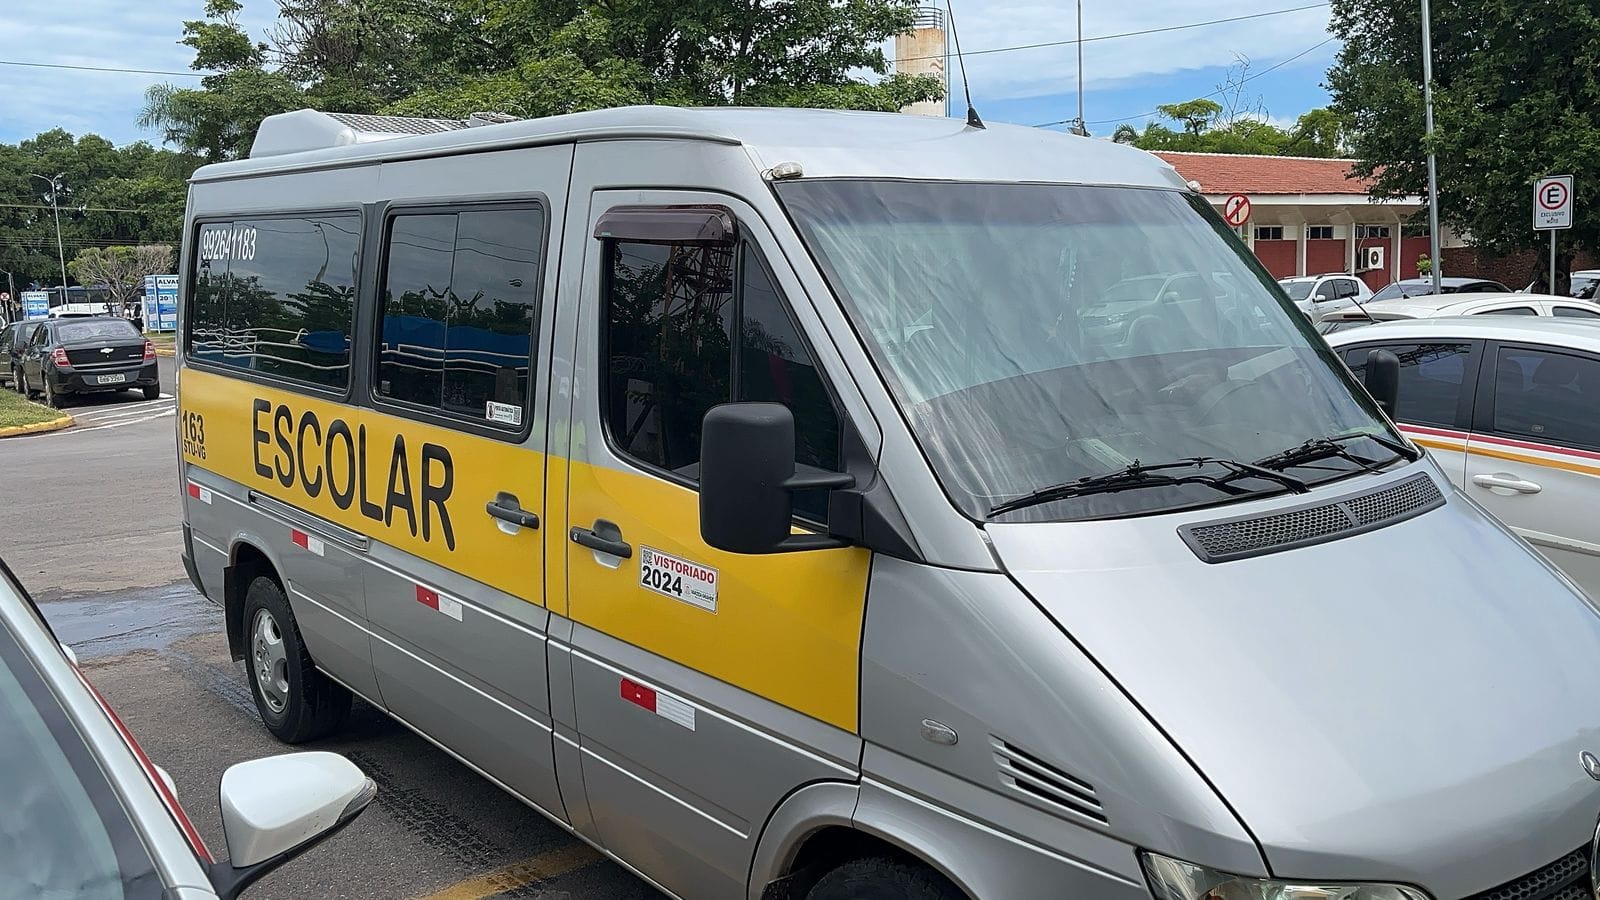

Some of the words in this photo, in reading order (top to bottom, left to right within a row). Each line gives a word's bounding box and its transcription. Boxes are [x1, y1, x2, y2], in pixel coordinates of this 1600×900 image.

[1547, 188, 1559, 204] E
[202, 228, 257, 261] 992641183
[182, 410, 205, 445] 163
[183, 439, 206, 460] STU-VG
[253, 398, 456, 552] ESCOLAR
[642, 565, 683, 597] 2024
[653, 554, 715, 584] VISTORIADO
